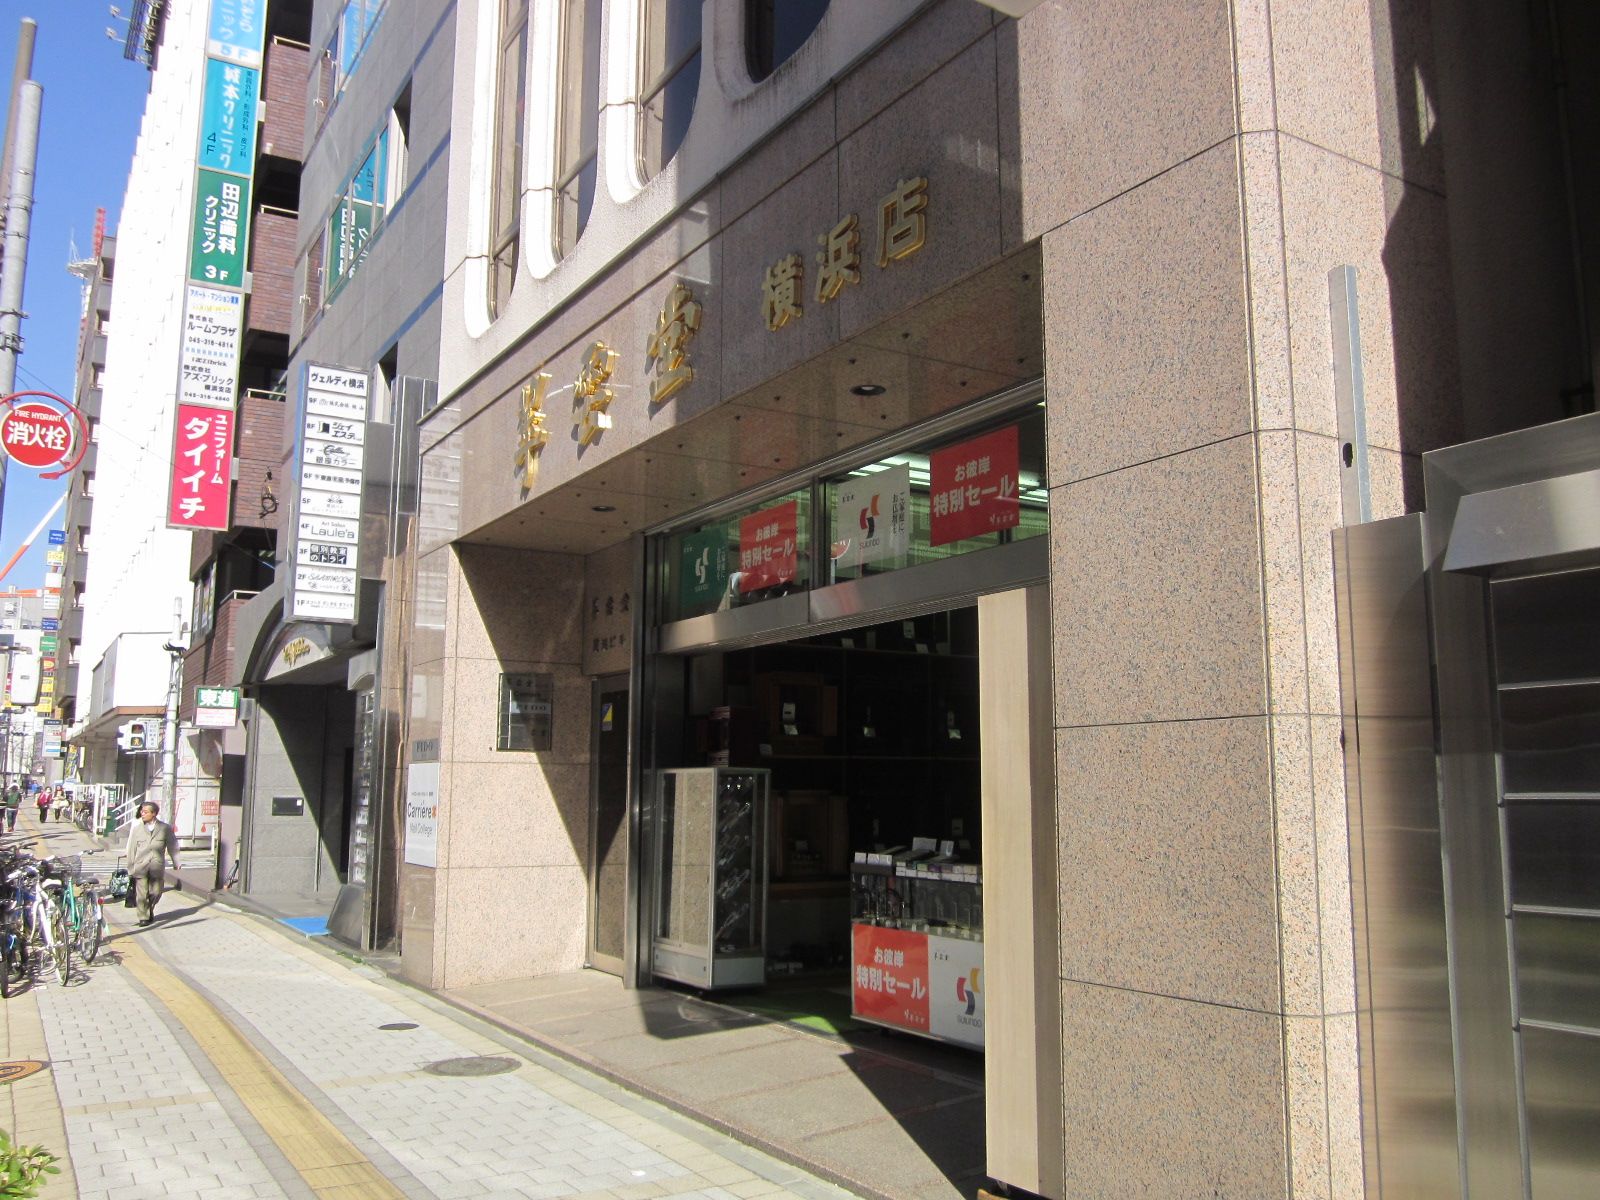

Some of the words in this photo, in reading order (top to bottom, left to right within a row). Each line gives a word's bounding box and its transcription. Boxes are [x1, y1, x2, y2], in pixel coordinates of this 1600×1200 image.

[201, 195, 219, 254] クリニック
[218, 182, 240, 256] 田辺歯科
[761, 176, 928, 331] 横浜店
[204, 265, 229, 281] 3F
[183, 364, 211, 374] 株式会社
[183, 371, 234, 385] アズ・ブリック
[311, 373, 364, 389] ヴェルディ横浜
[15, 409, 30, 418] FIRE
[31, 412, 62, 422] HYDRANT
[7, 420, 67, 451] 消火栓
[331, 430, 357, 439] エステ
[332, 422, 353, 431] ジェイ
[210, 414, 228, 485] ユニフォーム
[179, 417, 211, 520] ダイイチ
[955, 457, 991, 481] お彼岸
[933, 473, 1015, 519] 特別セール
[311, 526, 355, 539] Laule'a
[755, 522, 779, 543] お彼岸
[309, 553, 347, 565] のトライ
[741, 540, 794, 569] 特別セール
[200, 688, 235, 707] 東進
[874, 947, 904, 968] お彼岸
[856, 964, 926, 1000] 特別セール
